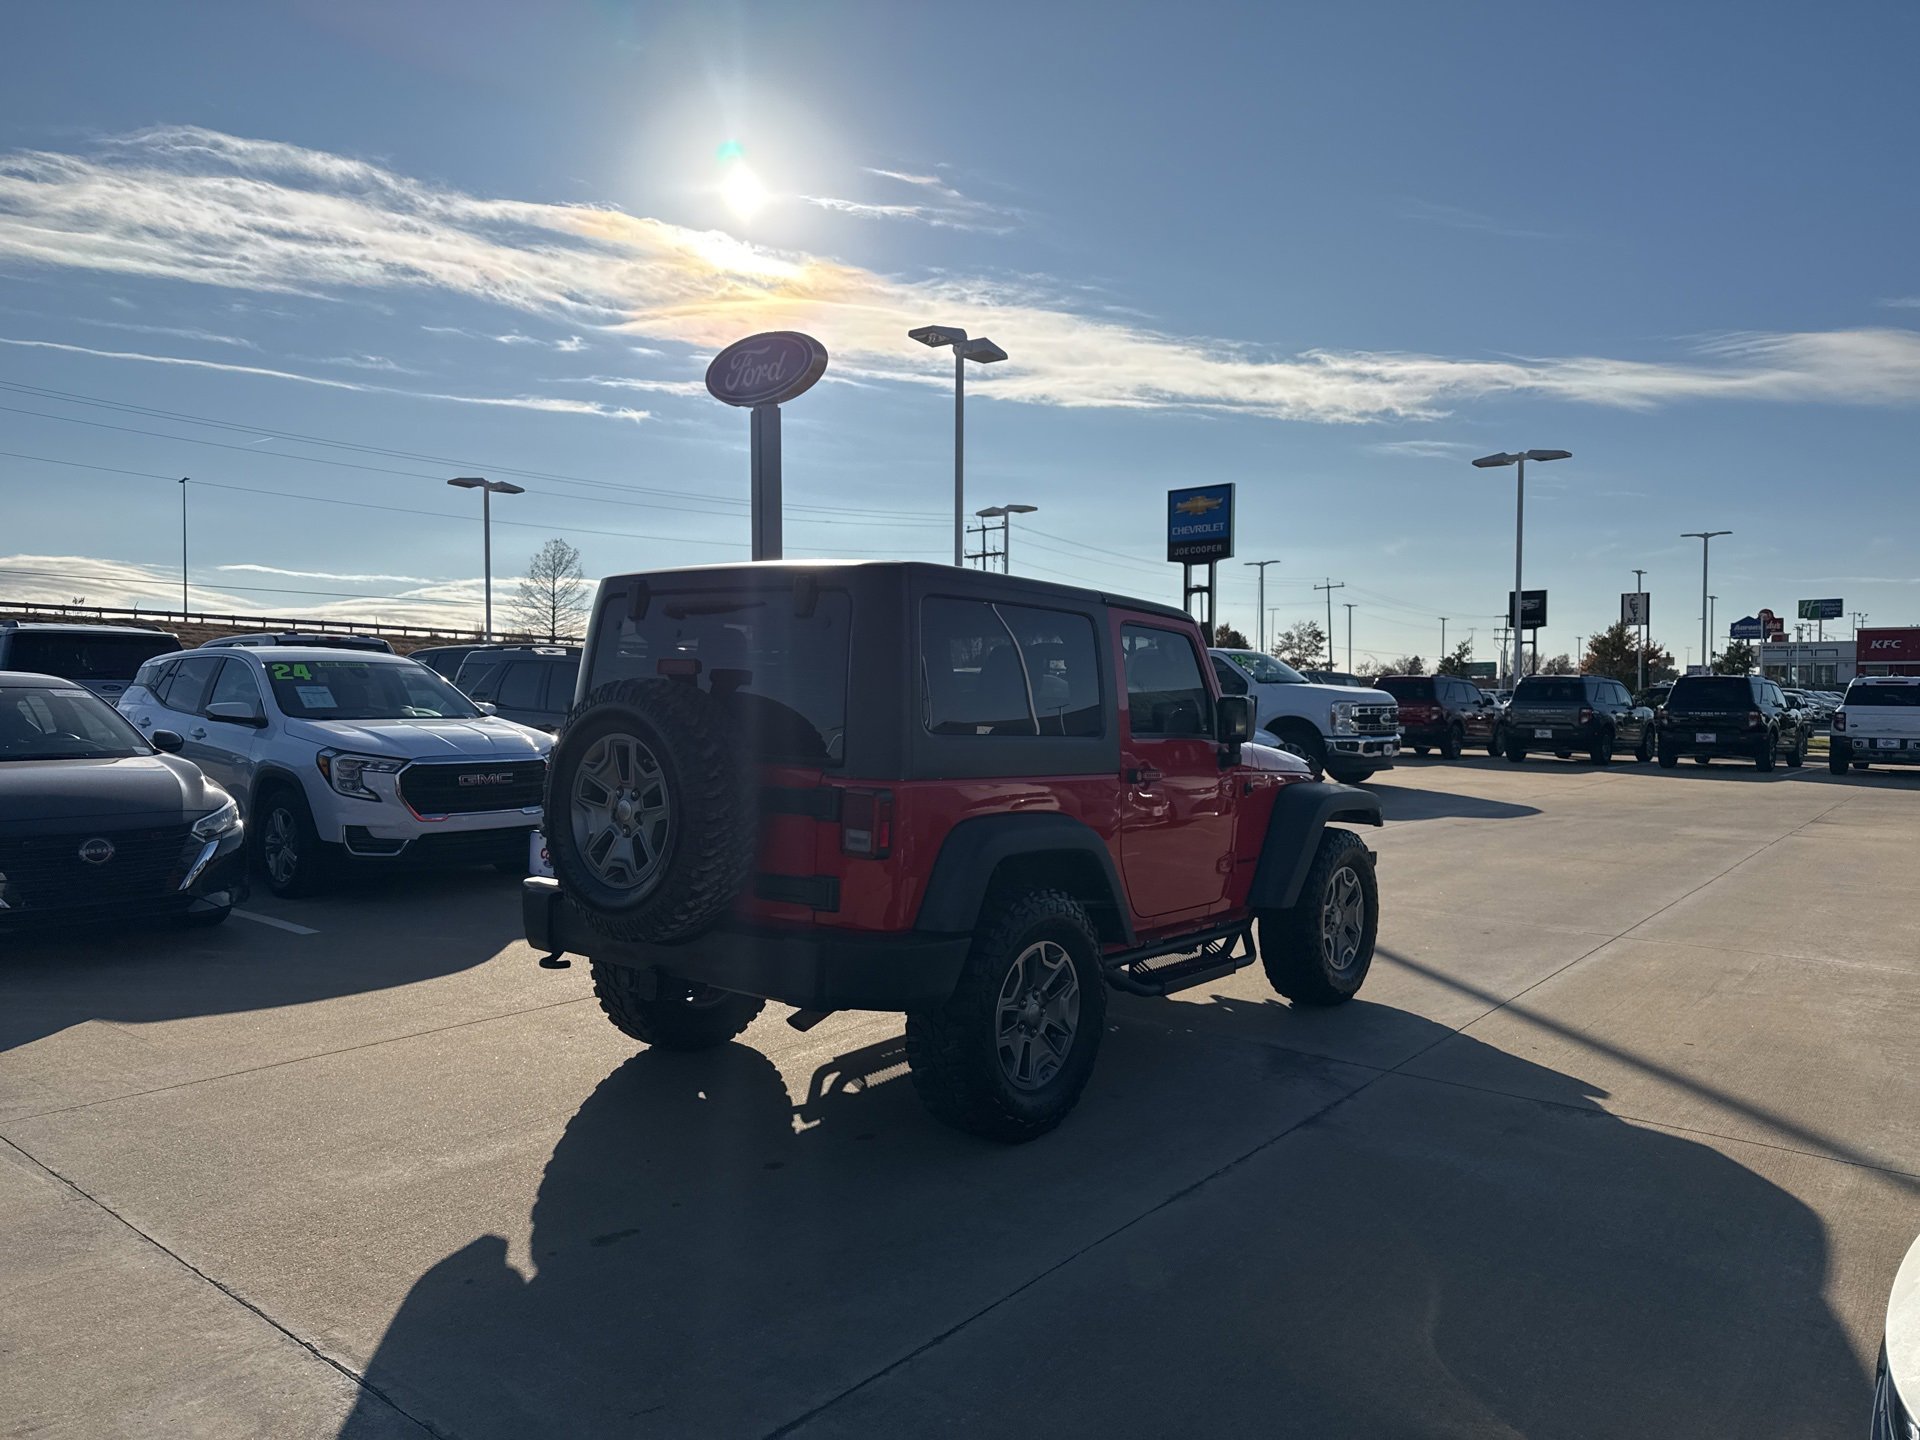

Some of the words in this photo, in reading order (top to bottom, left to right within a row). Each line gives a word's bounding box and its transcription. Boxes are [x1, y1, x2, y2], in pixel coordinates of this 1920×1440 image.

[725, 344, 787, 391] Ford
[1172, 522, 1225, 536] CHEVROLET
[1174, 546, 1190, 556] JOE
[1190, 544, 1222, 554] COOPER
[1870, 639, 1902, 649] KFC
[272, 663, 312, 681] 24
[459, 773, 514, 786] GMC
